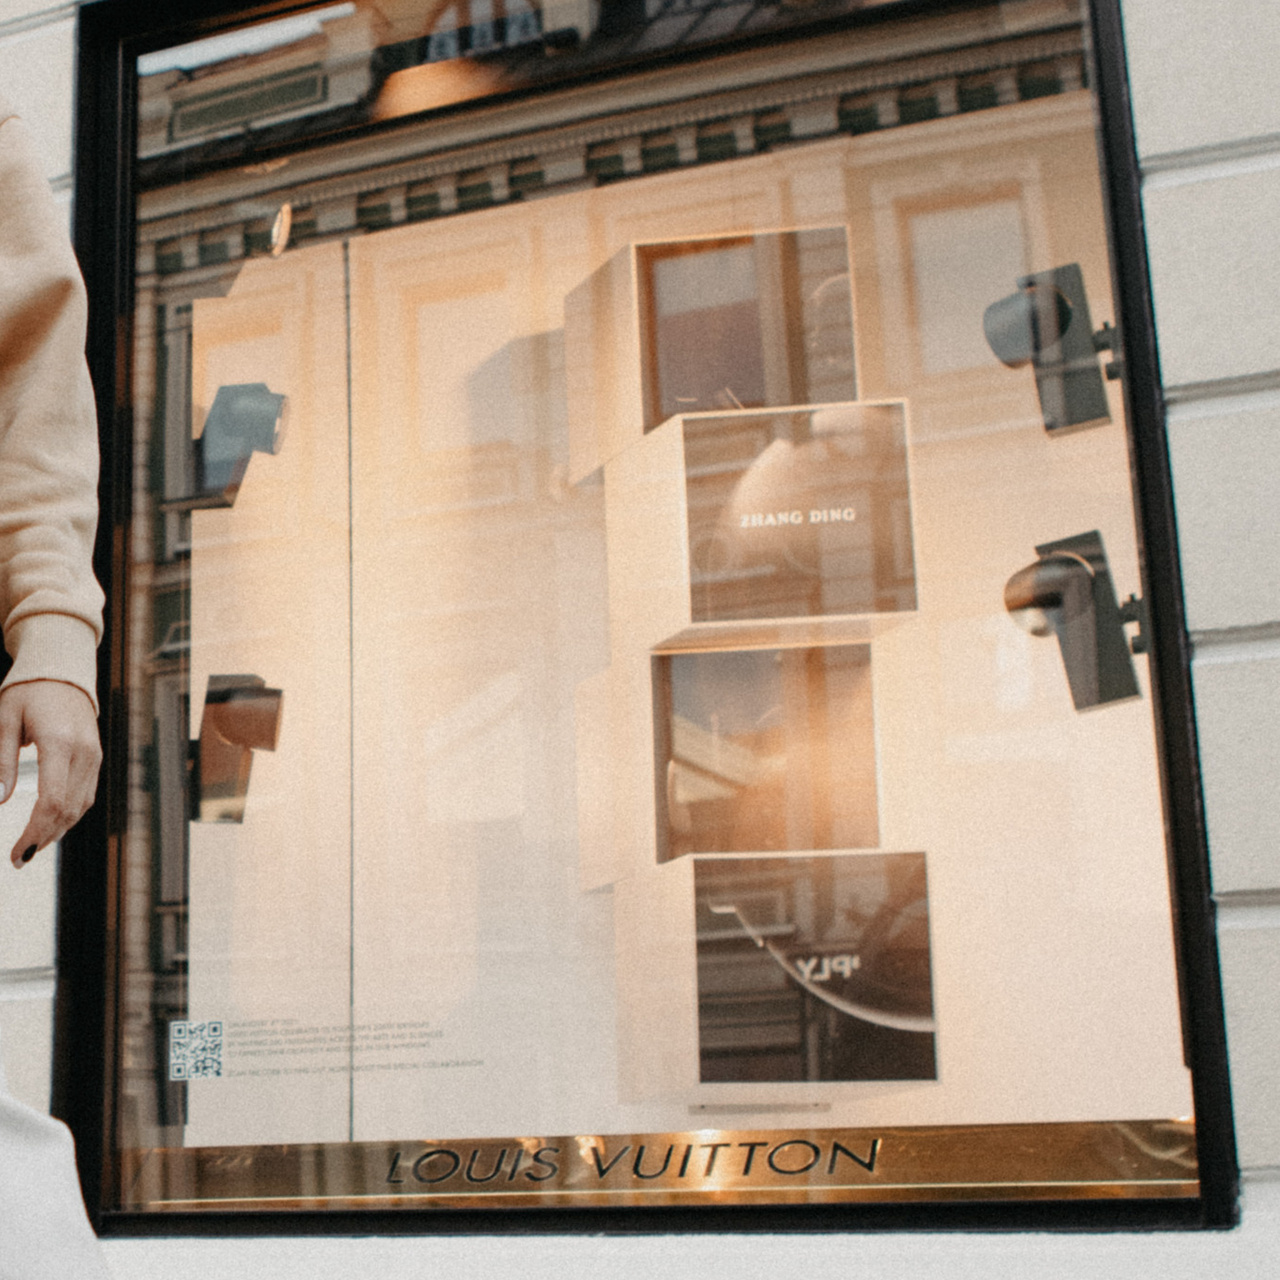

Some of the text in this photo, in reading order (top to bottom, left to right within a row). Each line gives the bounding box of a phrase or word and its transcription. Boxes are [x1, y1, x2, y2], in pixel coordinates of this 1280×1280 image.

[740, 507, 856, 528] ZHANG DING
[385, 1138, 882, 1184] LOUIS VUITTON
